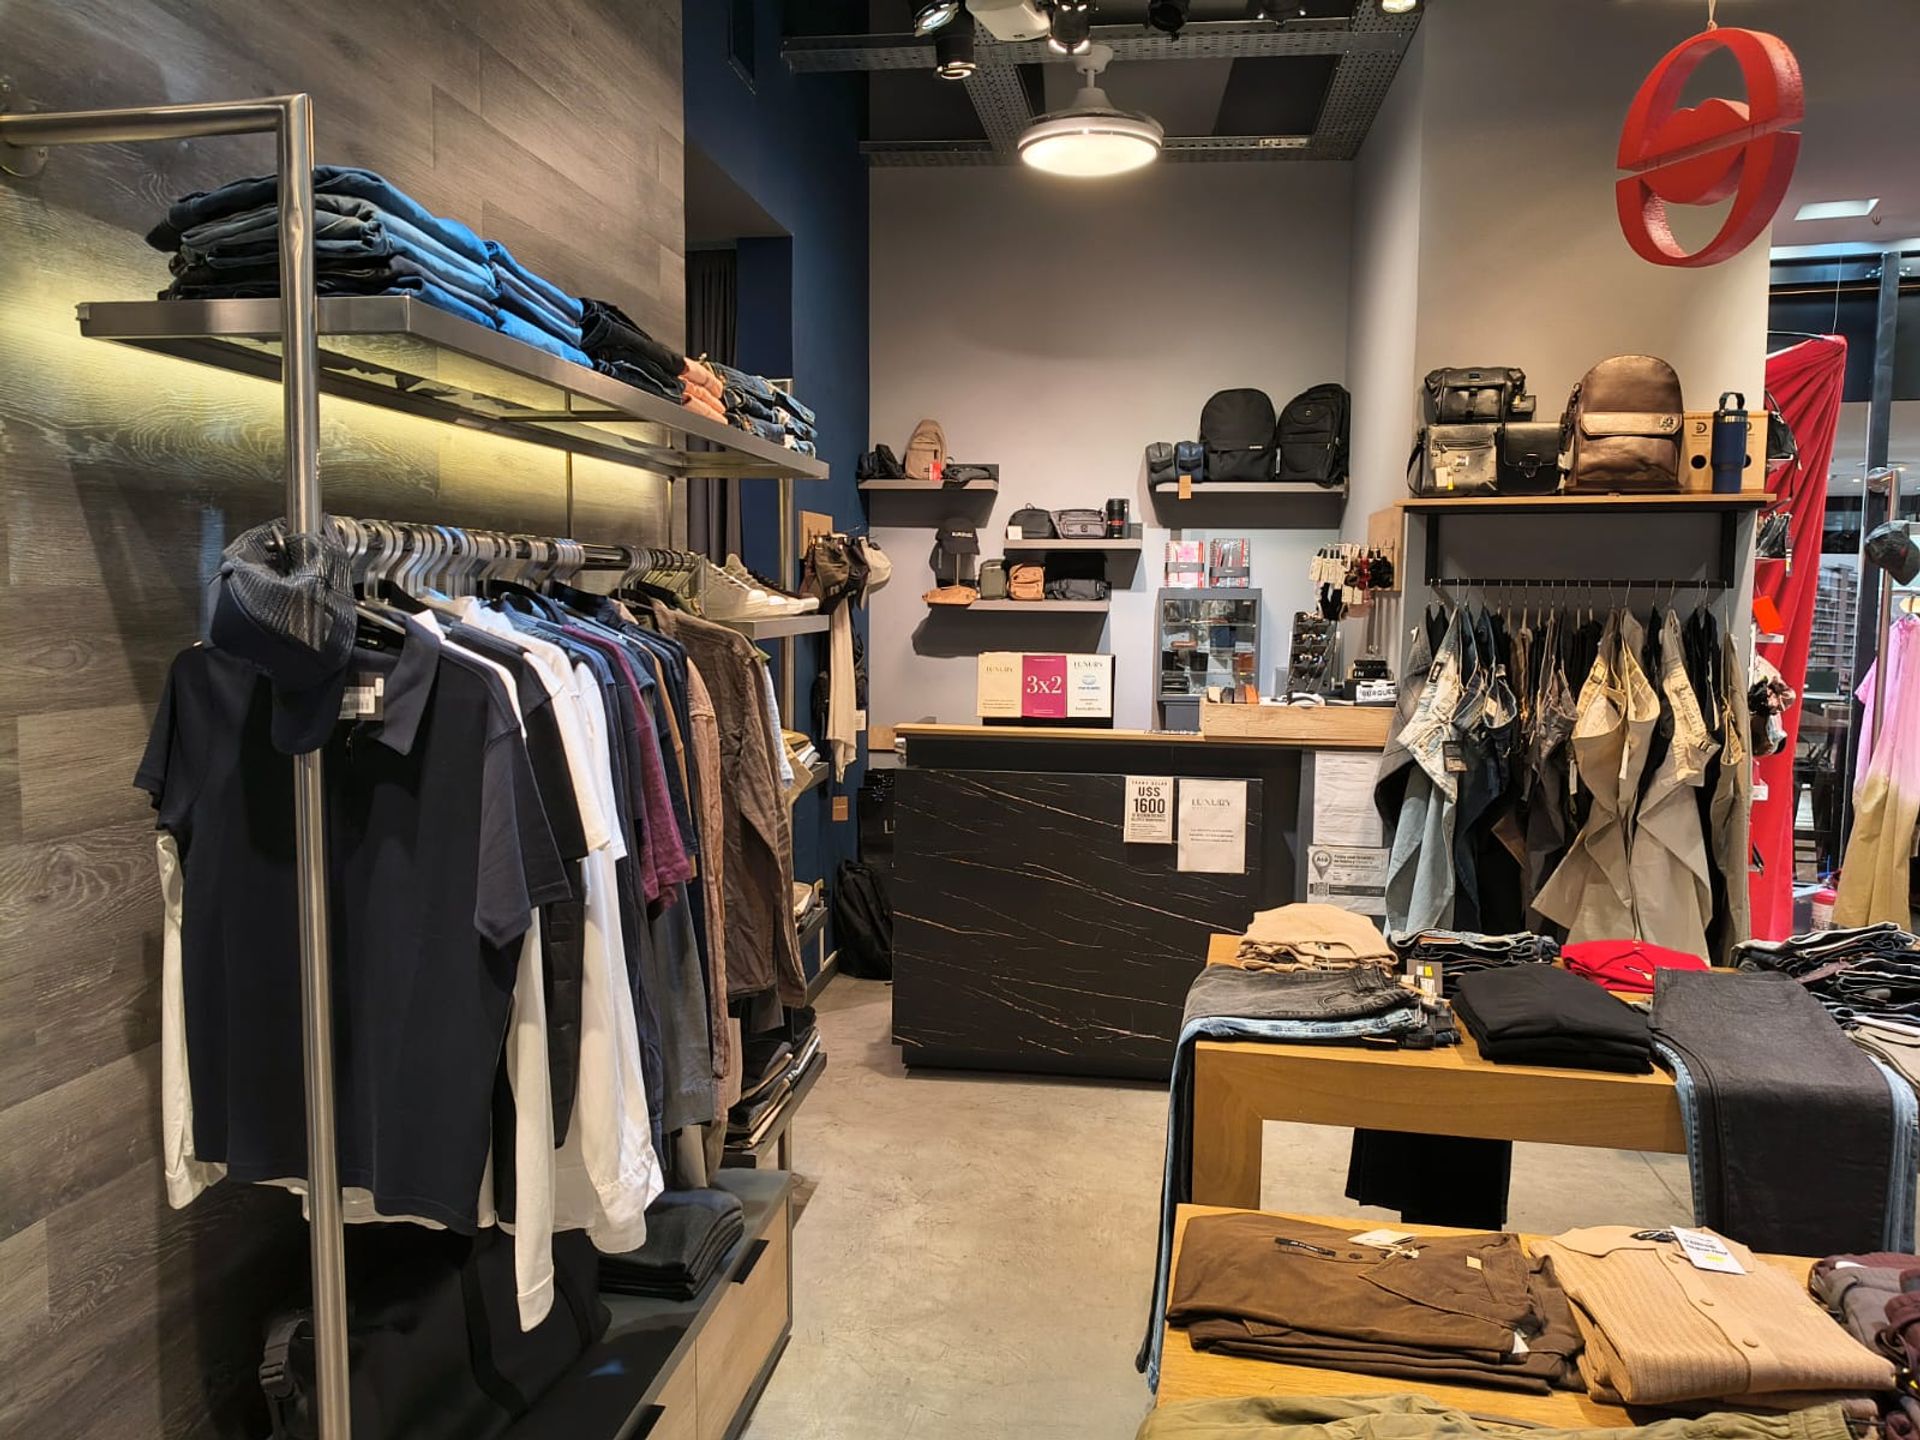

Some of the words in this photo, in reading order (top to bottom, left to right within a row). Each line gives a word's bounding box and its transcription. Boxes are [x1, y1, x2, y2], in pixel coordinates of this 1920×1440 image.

[1026, 675, 1062, 694] 3x2
[1133, 798, 1166, 814] 1600
[1191, 799, 1231, 807] LUXURY
